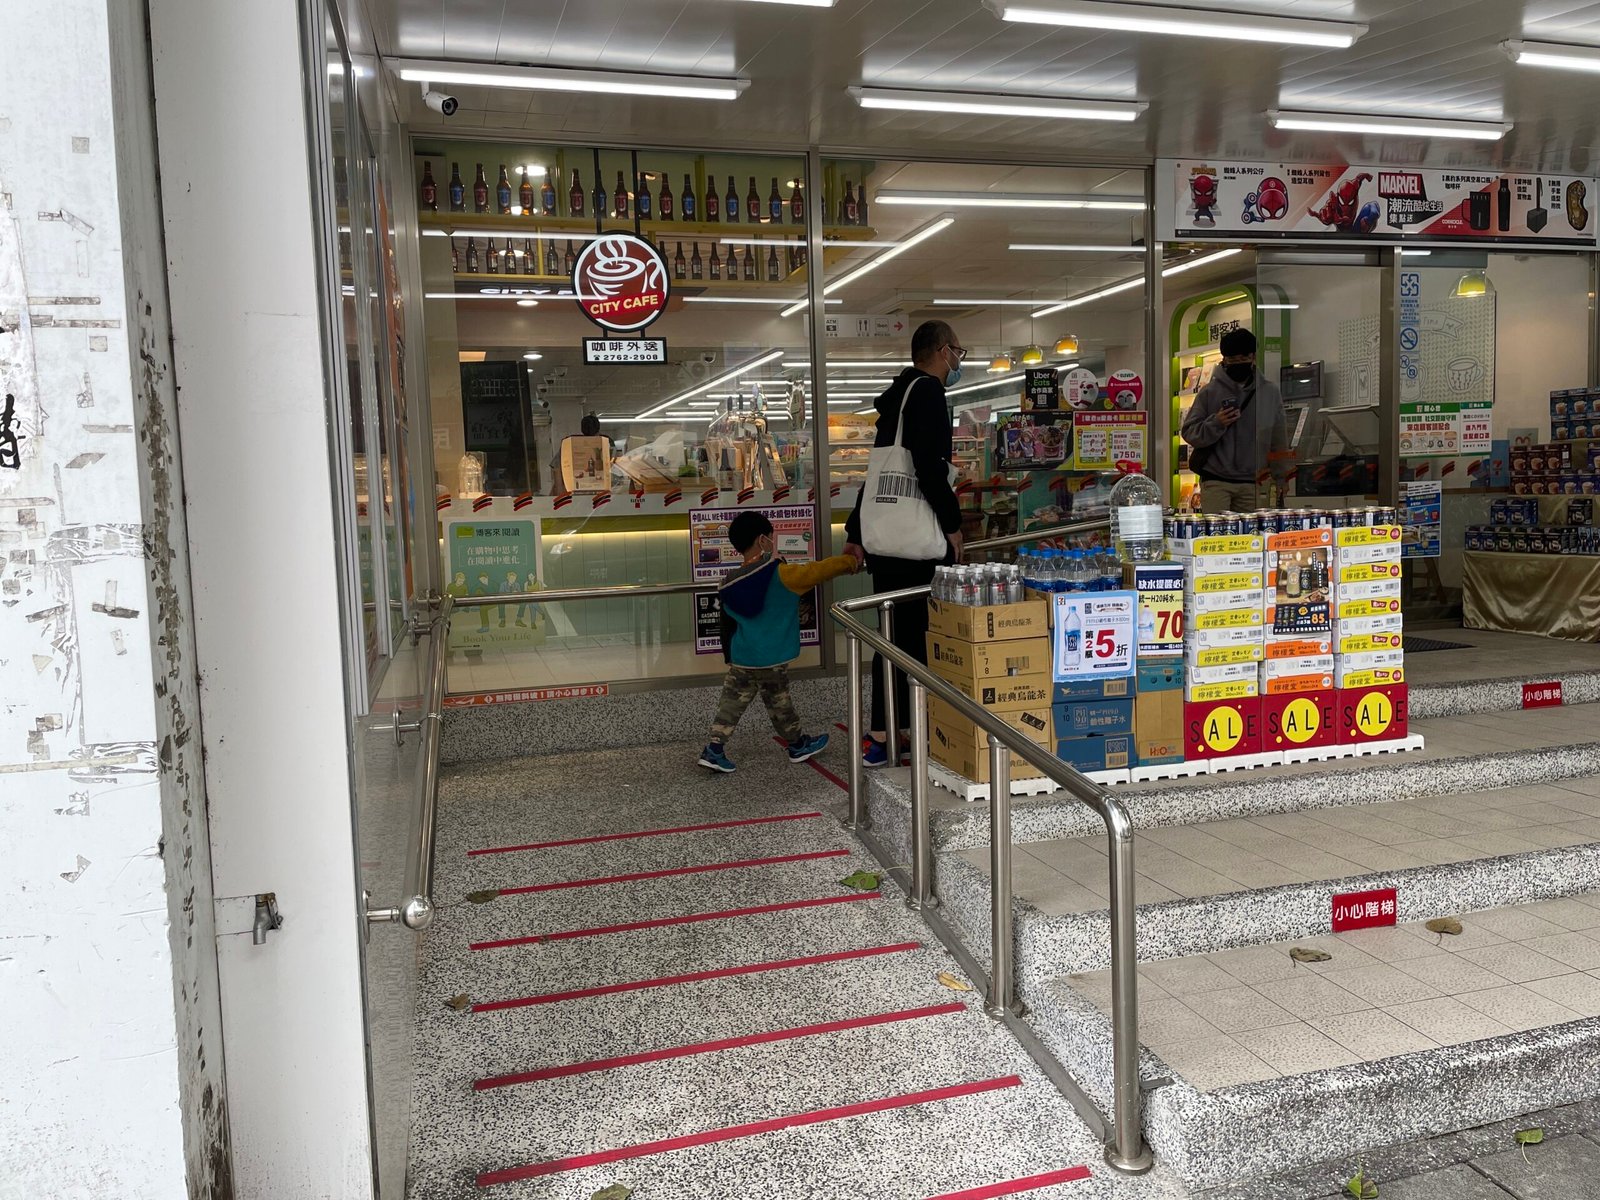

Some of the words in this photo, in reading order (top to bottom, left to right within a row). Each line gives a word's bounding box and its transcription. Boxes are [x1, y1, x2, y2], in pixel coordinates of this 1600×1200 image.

[1380, 174, 1420, 194] MARVEL
[1388, 198, 1443, 213] 潮流酷炫生活
[590, 300, 620, 315] CITY
[623, 293, 659, 310] CAFE
[592, 341, 658, 352] 咖啡外送
[1033, 371, 1050, 379] Uber
[1033, 379, 1050, 387] Eats
[1157, 610, 1184, 639] 70
[1311, 612, 1326, 624] 85
[463, 635, 487, 643] Book
[490, 634, 510, 642] Your
[513, 633, 531, 641] Life
[1085, 630, 1094, 659] 第2瓶
[984, 657, 989, 665] 7
[997, 689, 1046, 703] 經典烏龍茶
[1525, 688, 1561, 702] 小心階梯
[1064, 705, 1069, 713] 9
[1344, 700, 1405, 728] SALE
[1063, 714, 1070, 722] 10
[1269, 707, 1332, 734] SALE
[1191, 715, 1256, 743] SALE
[1335, 899, 1395, 921] 小心階梯
